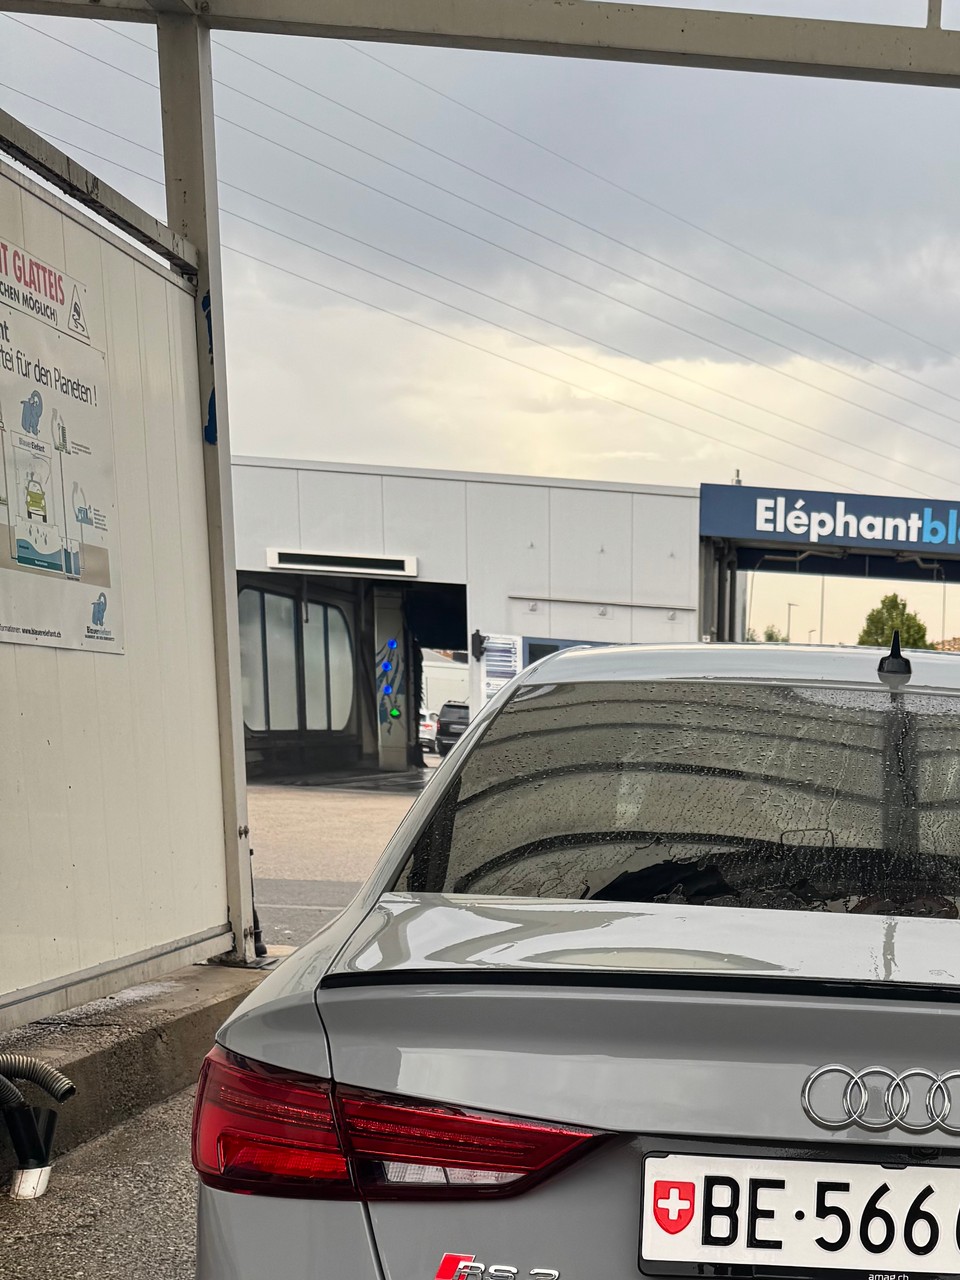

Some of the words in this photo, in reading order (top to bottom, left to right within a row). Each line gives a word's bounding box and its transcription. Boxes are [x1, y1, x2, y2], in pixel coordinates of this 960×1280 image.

[12, 249, 65, 306] GLATTEIS
[22, 291, 58, 327] MÖGLICH)
[16, 350, 32, 379] für
[33, 358, 53, 389] den
[53, 366, 93, 406] Planeten
